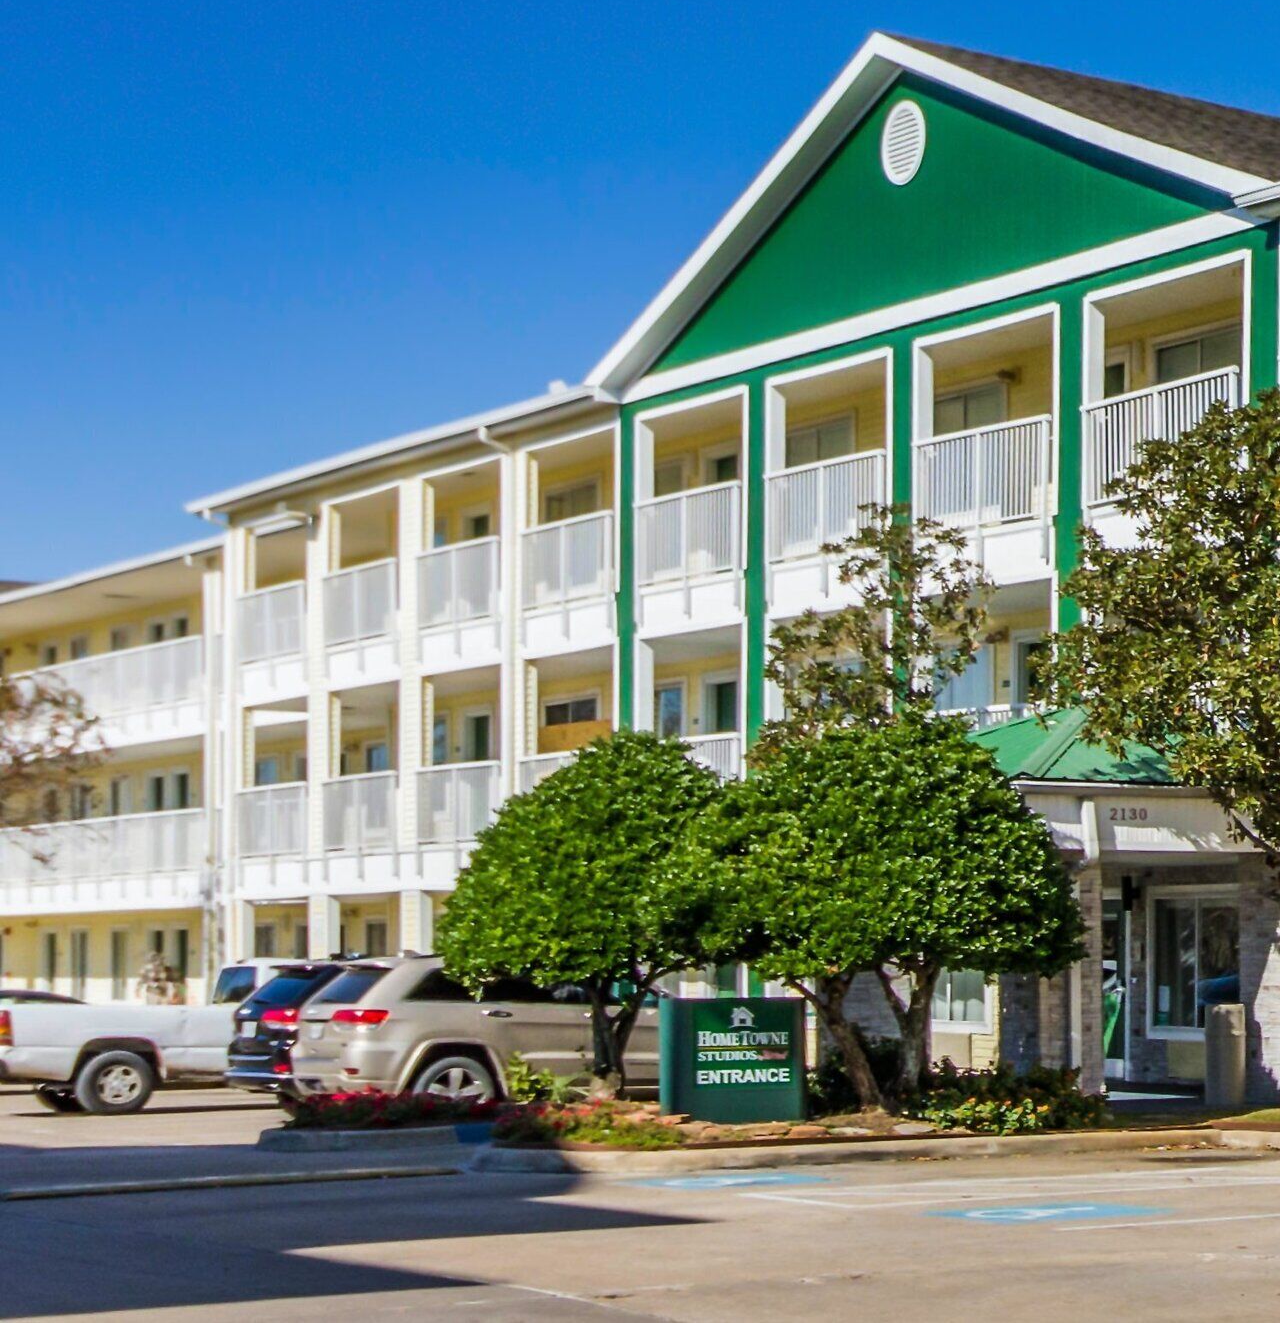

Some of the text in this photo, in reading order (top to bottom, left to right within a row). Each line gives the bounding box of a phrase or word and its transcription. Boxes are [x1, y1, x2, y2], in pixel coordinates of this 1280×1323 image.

[1109, 808, 1148, 821] 2130
[697, 1050, 759, 1062] STUDIOS
[696, 1068, 791, 1085] ENTRANCE
